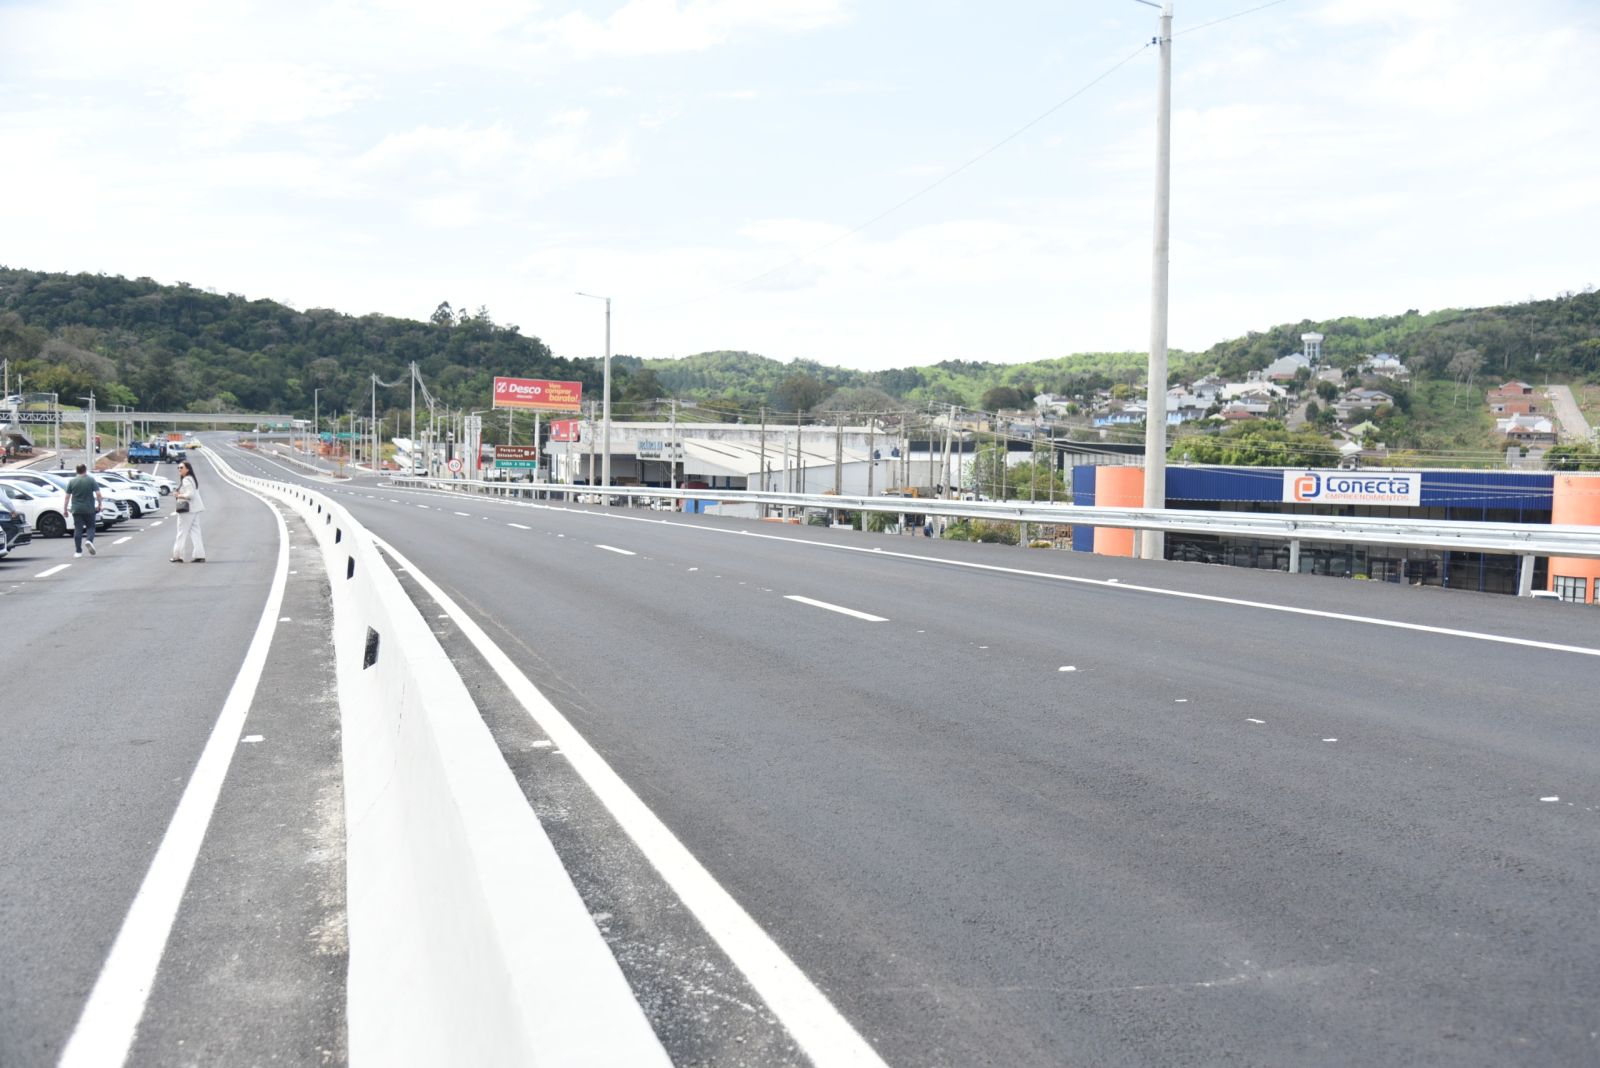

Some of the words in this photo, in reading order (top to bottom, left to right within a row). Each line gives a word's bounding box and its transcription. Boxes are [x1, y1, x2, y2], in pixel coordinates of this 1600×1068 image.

[509, 383, 541, 394] Desco
[549, 394, 579, 402] barato!
[1326, 476, 1410, 494] Conecta
[1325, 493, 1409, 501] EMPREENDIMENTOS
